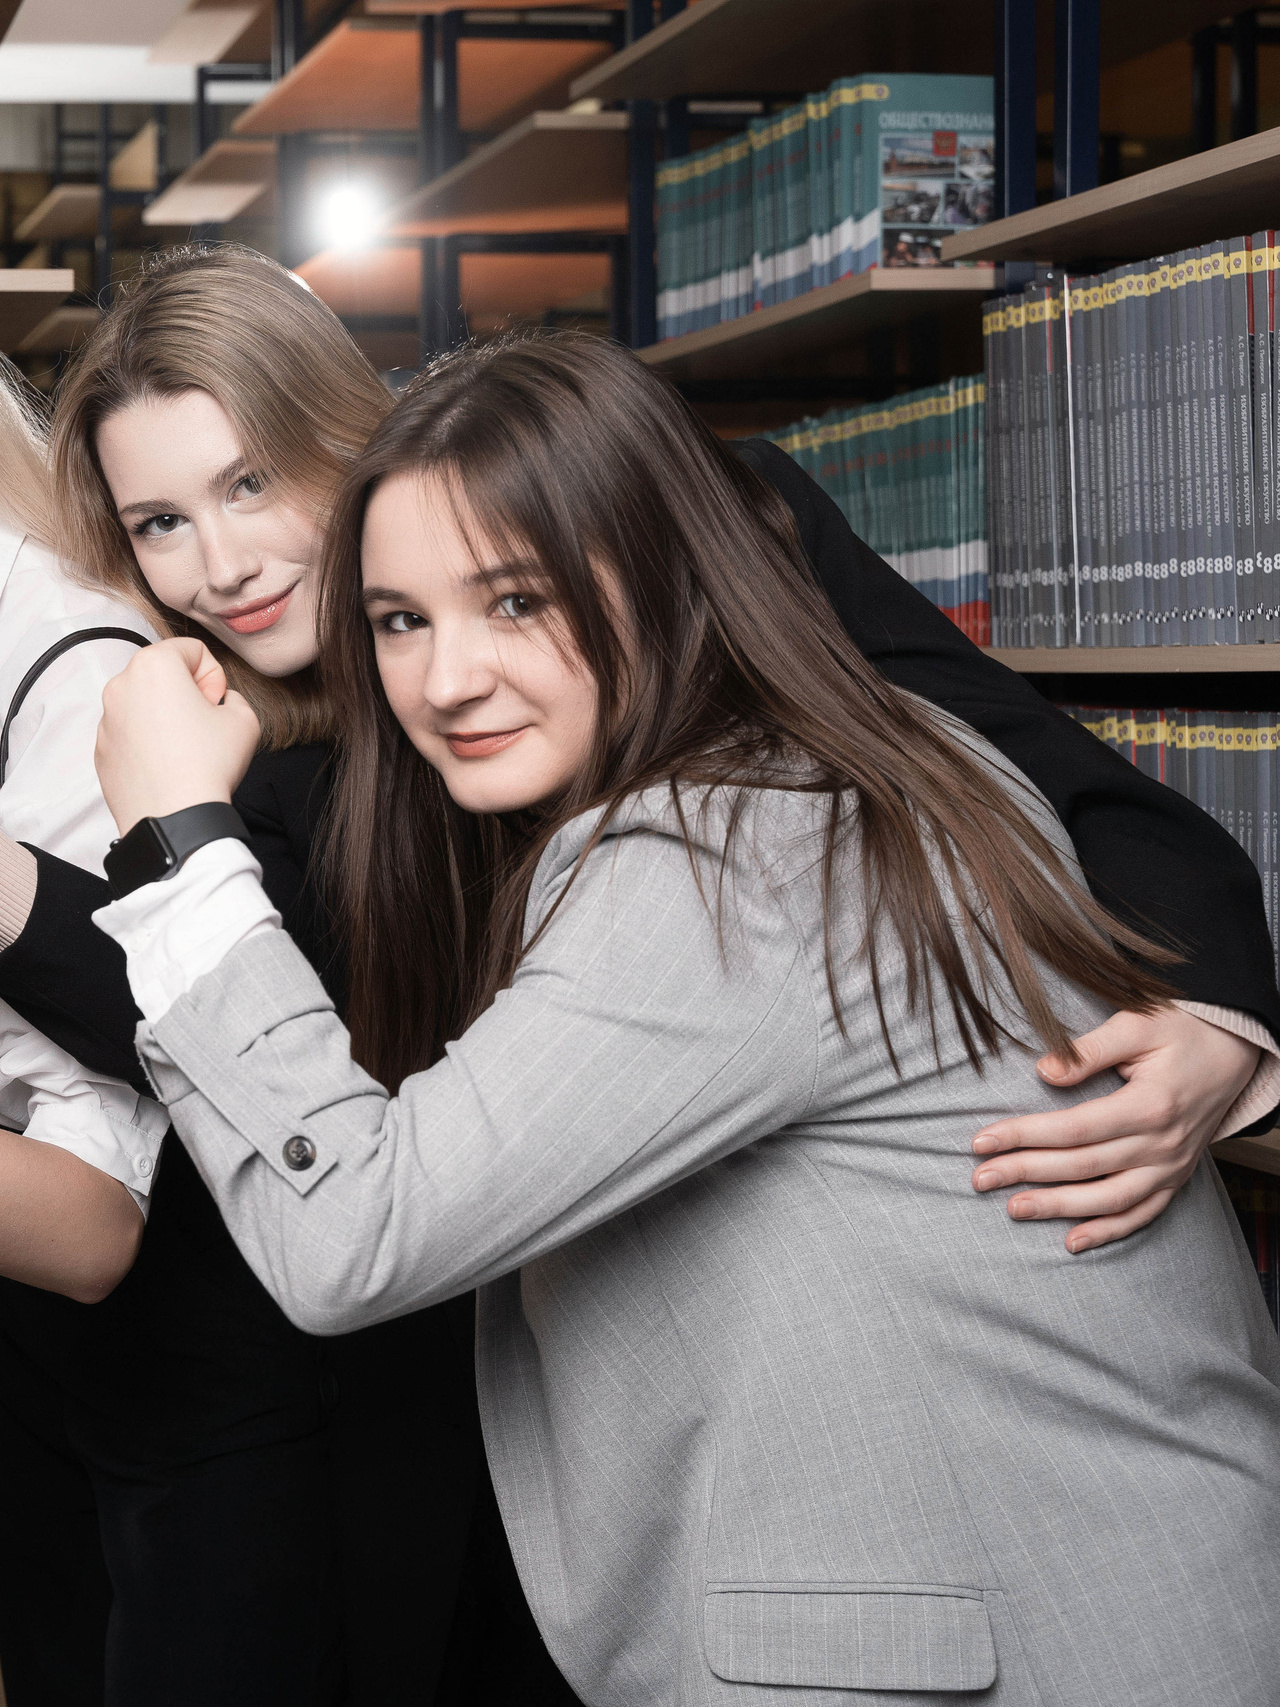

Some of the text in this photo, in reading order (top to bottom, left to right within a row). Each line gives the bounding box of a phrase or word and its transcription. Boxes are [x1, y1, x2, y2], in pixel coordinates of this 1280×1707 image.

[1124, 563, 1133, 580] 8
[1134, 560, 1143, 577] 8
[1144, 562, 1153, 579] 8
[1160, 562, 1169, 579] 8
[1169, 557, 1178, 574] 8
[1187, 559, 1196, 576] 8
[1196, 556, 1206, 573] 8
[1206, 557, 1214, 574] 8
[1214, 557, 1224, 574] 8
[1224, 554, 1233, 572] 8
[1244, 557, 1254, 575] 8
[1263, 556, 1273, 574] 8
[1082, 564, 1090, 581] 8
[1092, 568, 1100, 583] 8
[1100, 565, 1108, 582] 8
[1117, 566, 1124, 582] 8
